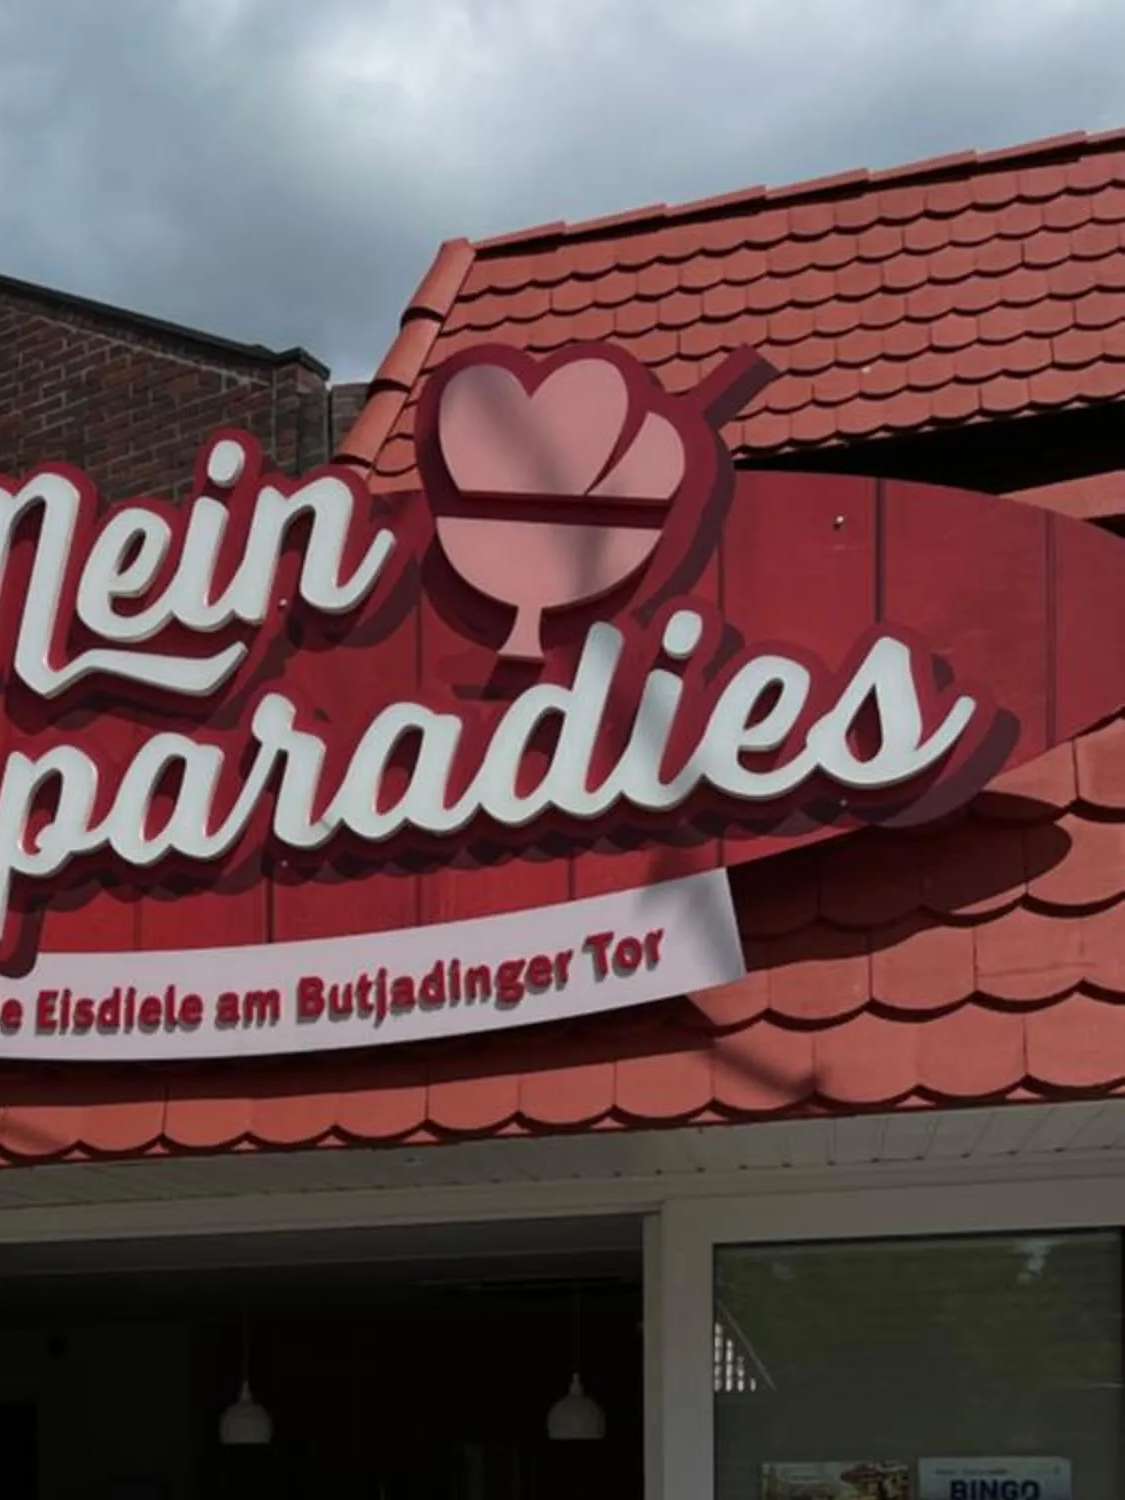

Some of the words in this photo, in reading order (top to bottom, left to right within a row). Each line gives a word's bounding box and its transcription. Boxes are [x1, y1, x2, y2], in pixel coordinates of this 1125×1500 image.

[35, 984, 204, 1031] Eisdiele
[214, 985, 282, 1024] am
[295, 948, 574, 1028] Butjadinger
[589, 926, 666, 975] Tor
